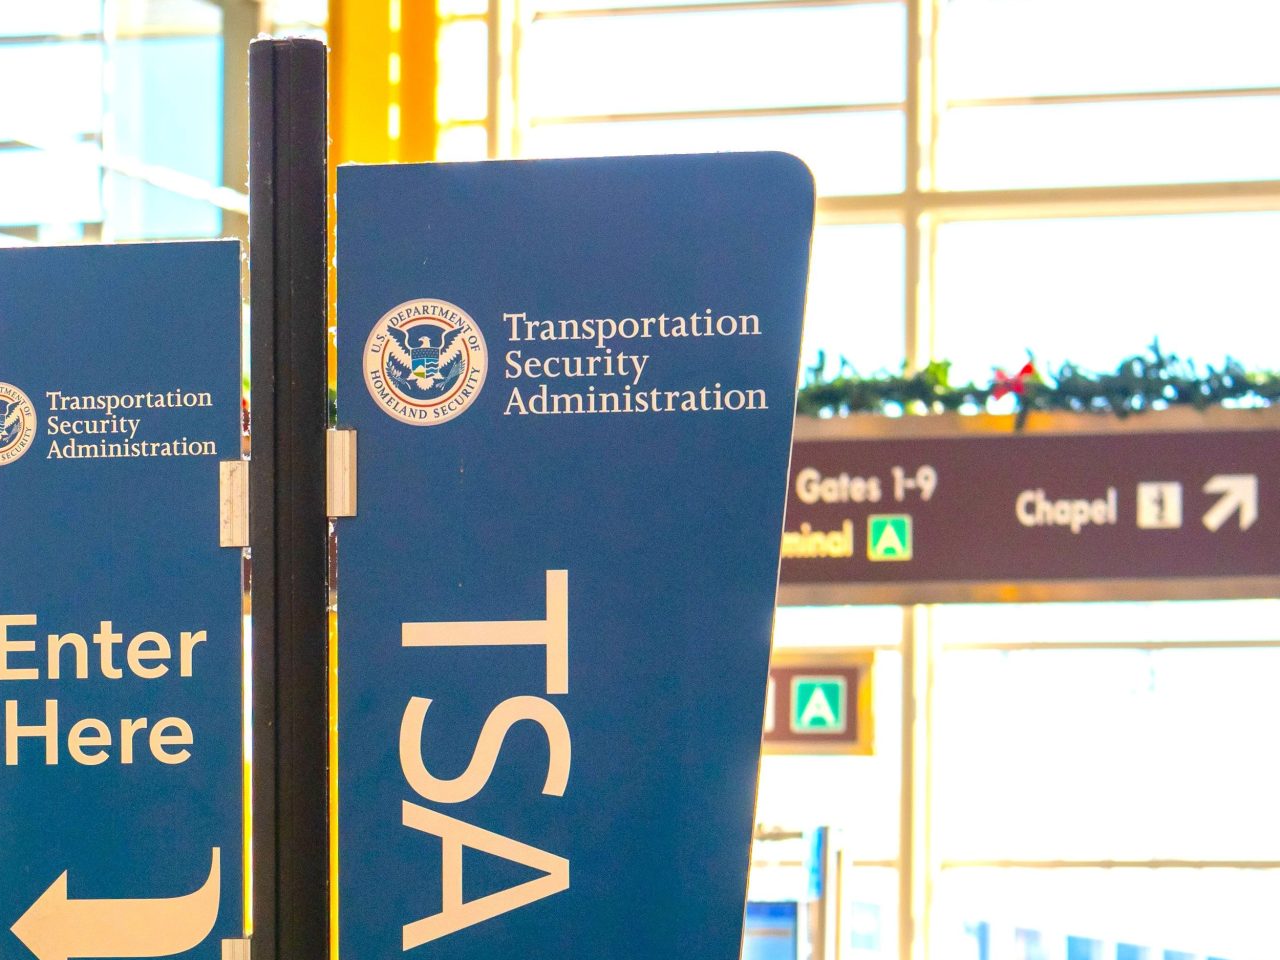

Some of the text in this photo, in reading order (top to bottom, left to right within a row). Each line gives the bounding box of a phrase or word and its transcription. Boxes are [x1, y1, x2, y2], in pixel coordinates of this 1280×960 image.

[371, 305, 480, 353] U.S. DEPARTMENT OF
[503, 309, 762, 348] Transportation
[505, 349, 648, 384] Security
[23, 406, 32, 417] OF
[46, 389, 213, 416] Transportation
[371, 367, 480, 420] HOMELAND SECURITY
[503, 383, 768, 415] Administration
[1, 427, 32, 460] SECURITY
[47, 416, 140, 438] Security
[46, 437, 217, 459] Administration
[795, 464, 938, 504] Gates 1-9
[1015, 487, 1118, 533] Chapel
[781, 518, 854, 559] minal
[5, 699, 194, 766] Here
[399, 569, 571, 952] TSA
